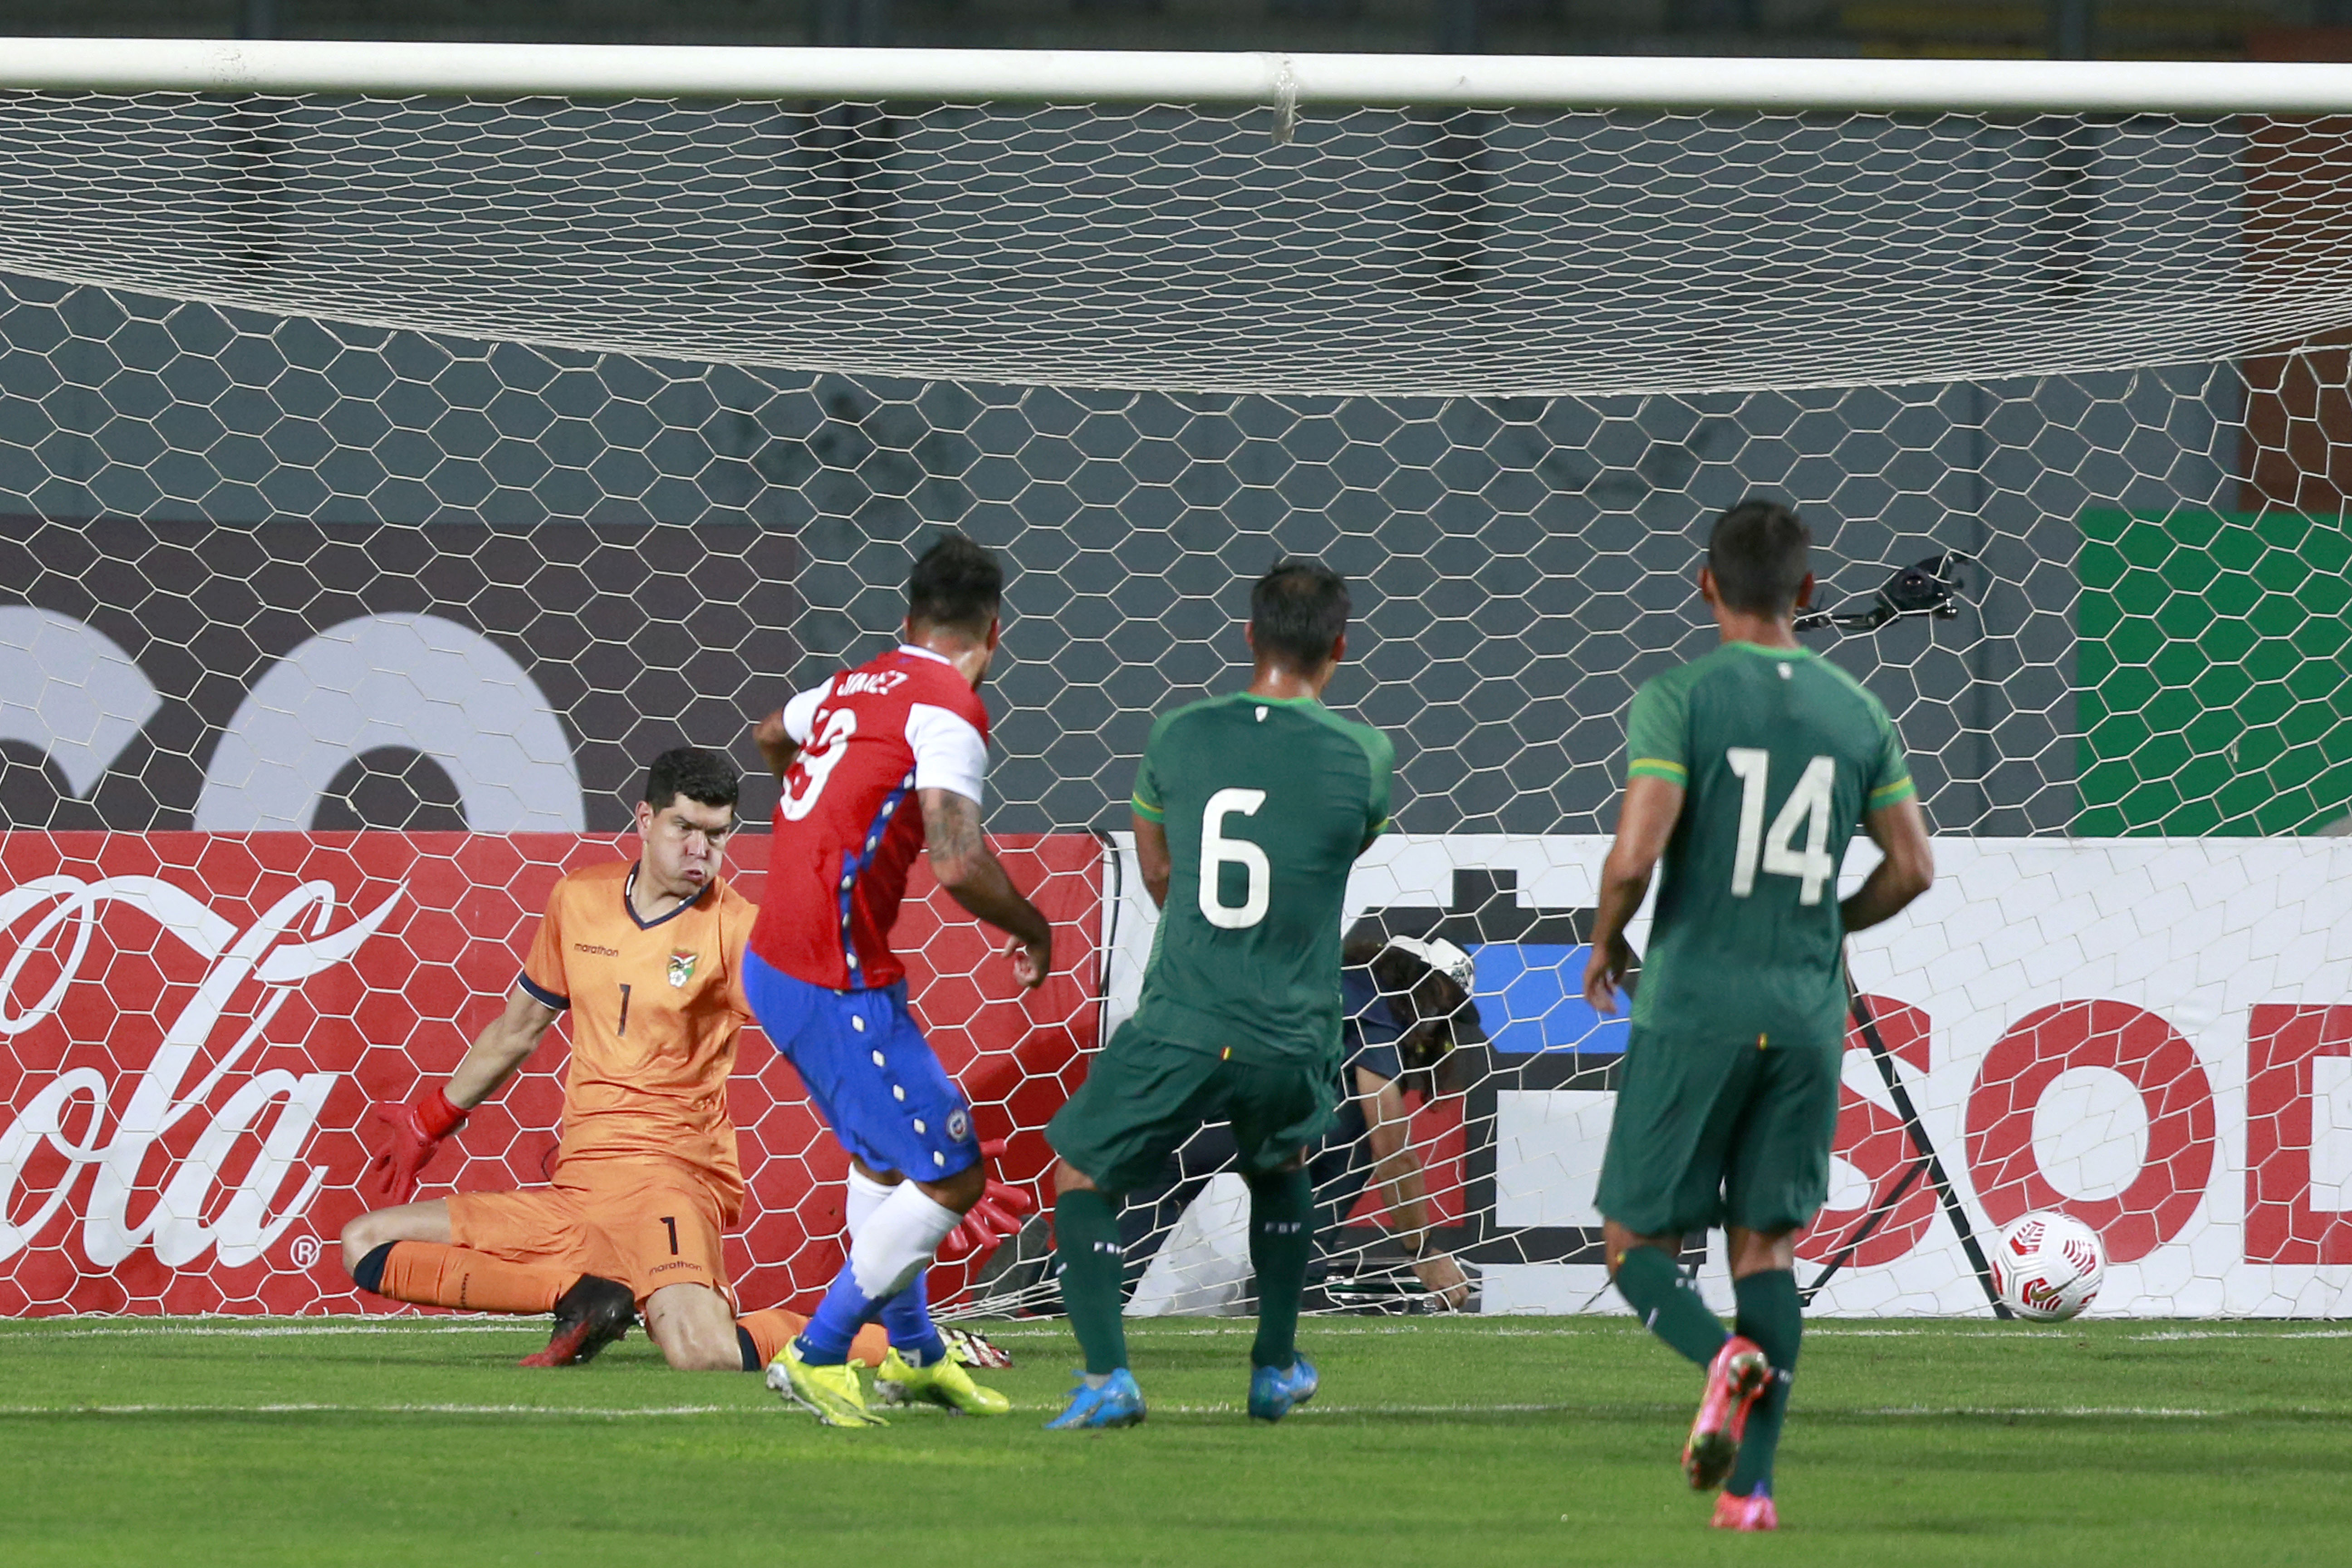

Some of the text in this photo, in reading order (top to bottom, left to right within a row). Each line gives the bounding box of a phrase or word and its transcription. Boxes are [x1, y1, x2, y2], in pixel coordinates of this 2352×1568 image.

[1725, 746, 1836, 905] 14
[1198, 787, 1270, 929] 6
[573, 942, 619, 957] marathon
[617, 983, 632, 1038] 1
[659, 1216, 678, 1255] 1
[649, 1260, 702, 1277] marathon
